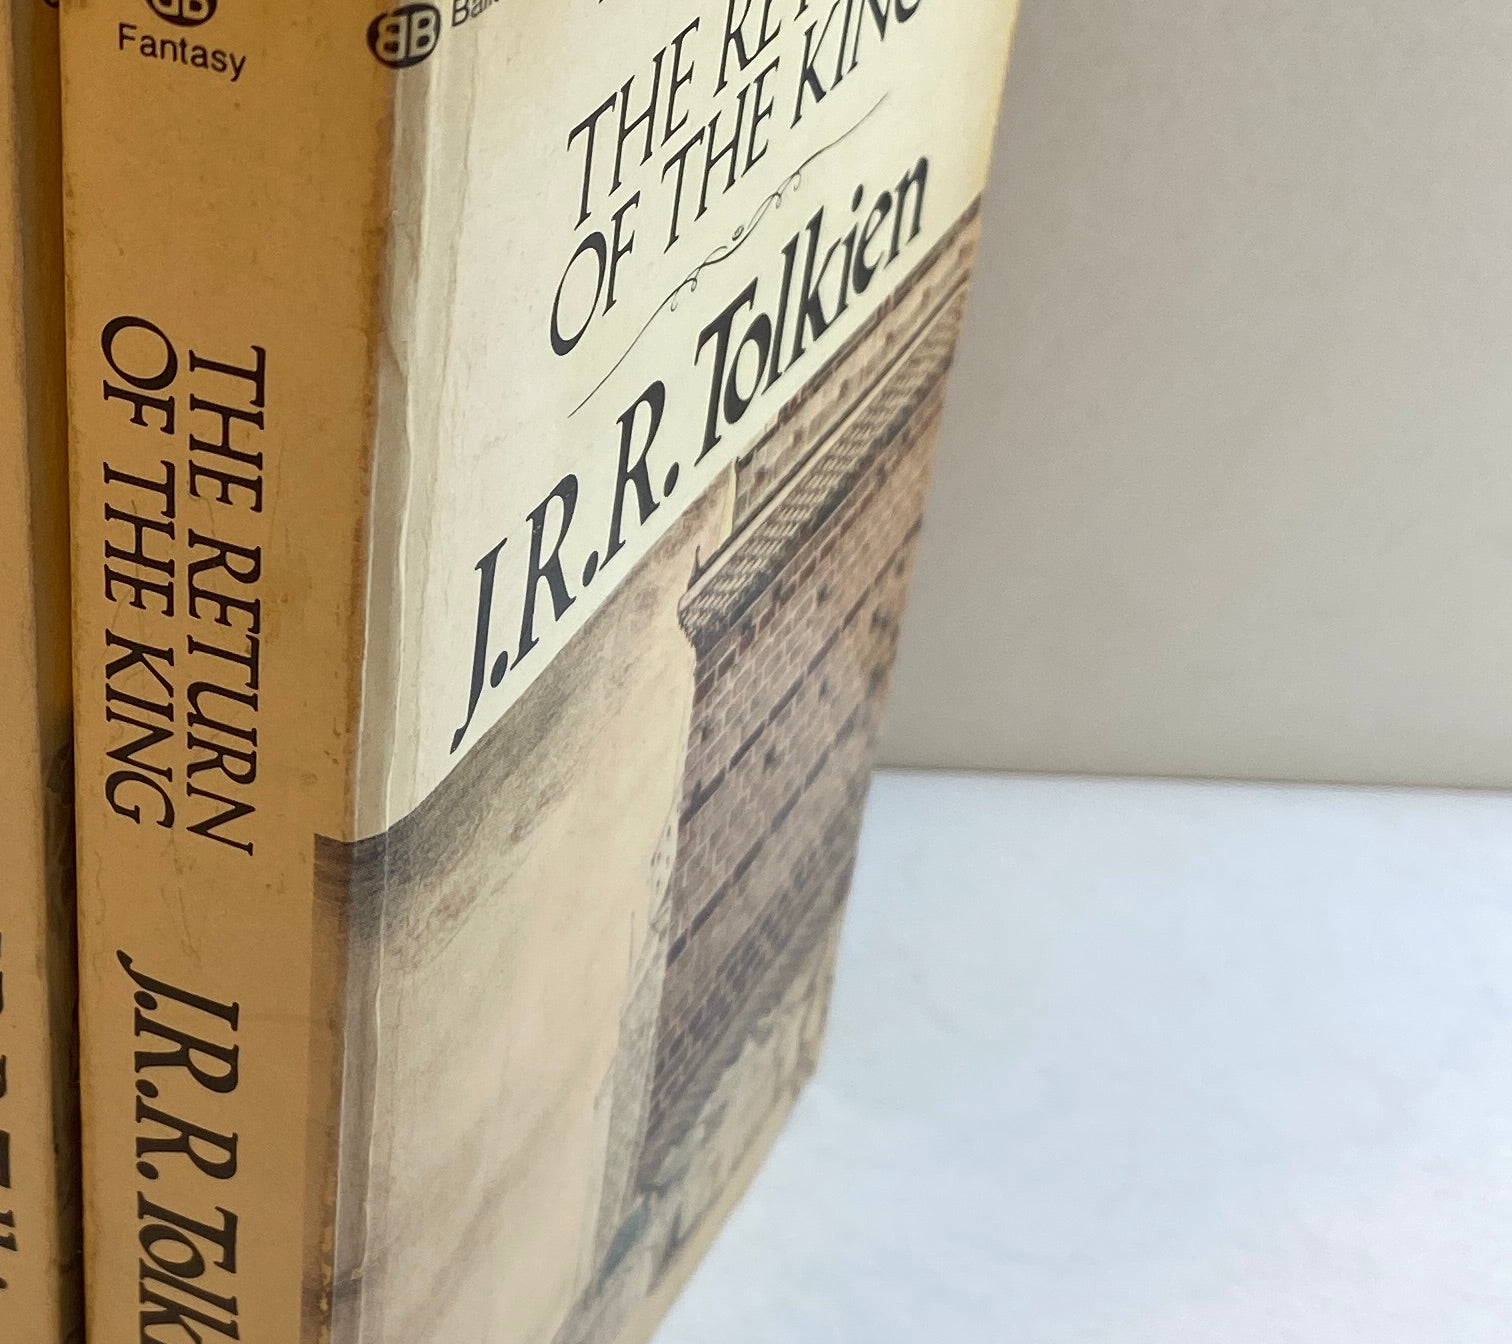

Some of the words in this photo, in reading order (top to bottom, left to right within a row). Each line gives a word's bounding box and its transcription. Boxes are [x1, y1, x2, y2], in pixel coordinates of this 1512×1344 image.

[118, 23, 246, 82] Fantasy
[567, 17, 700, 231] THE
[549, 190, 640, 357] OF
[661, 55, 780, 256] THE
[100, 315, 178, 435] OF
[188, 345, 266, 513] THE
[450, 379, 681, 756] J.R.R.
[693, 157, 929, 467] Tolkien
[103, 460, 176, 617] THE
[105, 629, 175, 829] KING
[186, 528, 262, 856] RETURN
[116, 949, 239, 1181] J.R.R.
